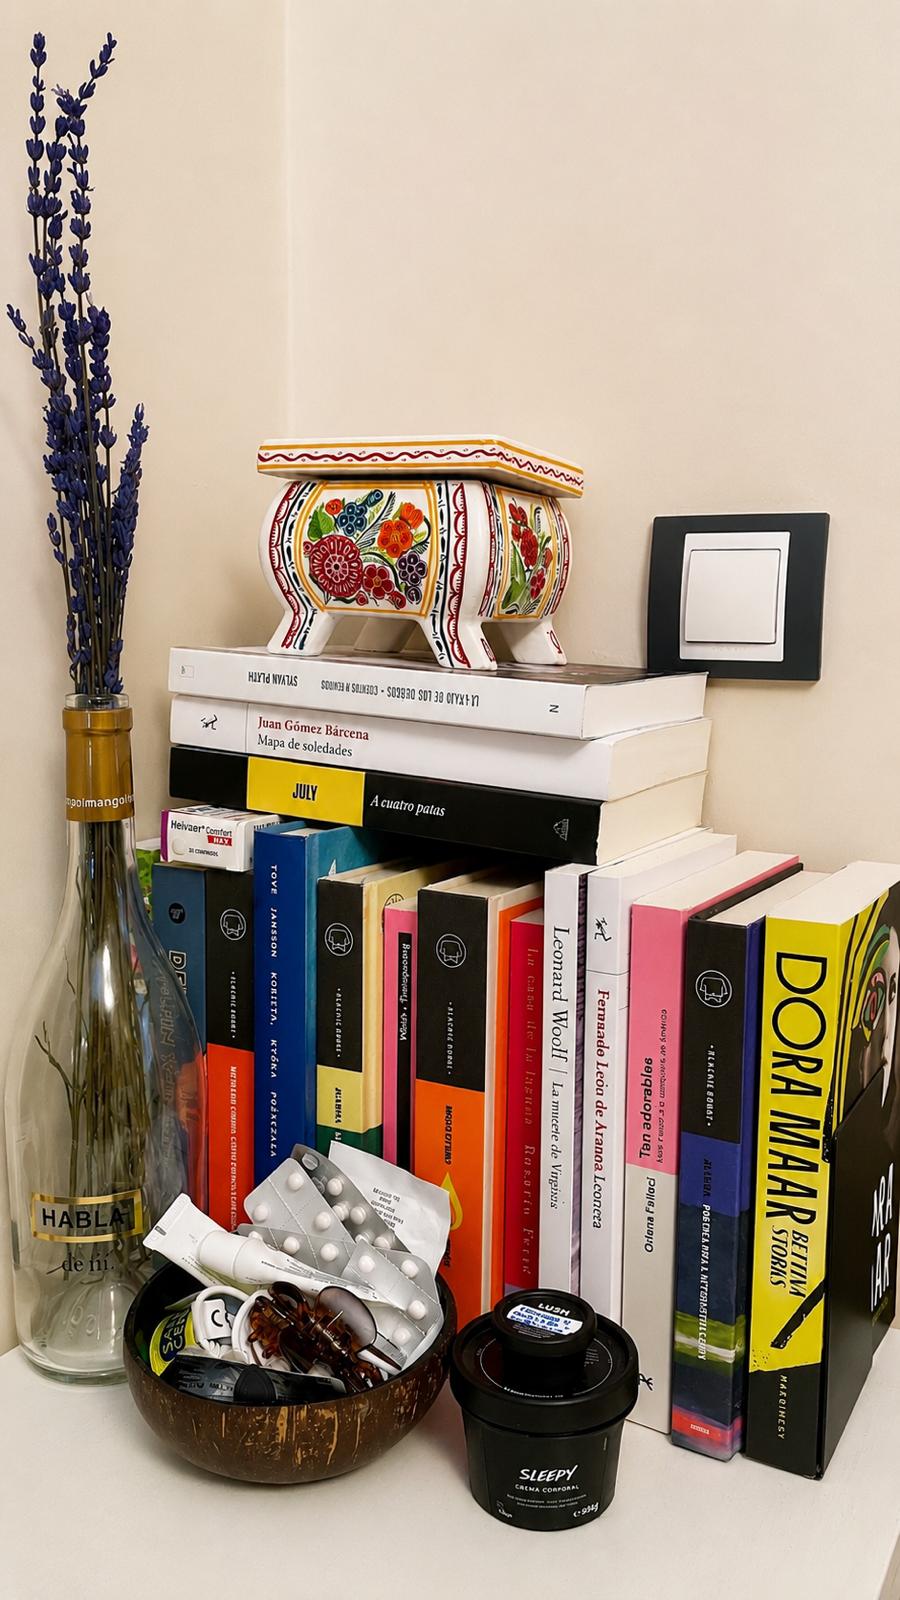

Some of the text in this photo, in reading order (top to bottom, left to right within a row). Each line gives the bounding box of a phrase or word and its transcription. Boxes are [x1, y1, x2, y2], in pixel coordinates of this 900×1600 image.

[258, 716, 369, 740] Juan Gómez Bárcena
[257, 733, 353, 757] Mapa de soledades
[292, 782, 318, 801] JULY
[370, 795, 446, 817] A cuatro patas
[270, 907, 278, 958] JANSSON
[552, 926, 569, 1002] Leonard
[551, 1009, 568, 1063] Woolf
[552, 1081, 563, 1097] La
[764, 952, 828, 1225] DORA MAAR
[595, 1100, 607, 1117] de
[640, 1057, 653, 1158] Tan adorables
[551, 1144, 562, 1159] de
[42, 1208, 125, 1229] HABLA
[62, 1253, 84, 1273] de
[768, 1225, 788, 1290] STORKS
[788, 1230, 809, 1298] BETTINA
[519, 1464, 578, 1482] SLEEPY
[515, 1484, 580, 1494] CREMA CORPORAL
